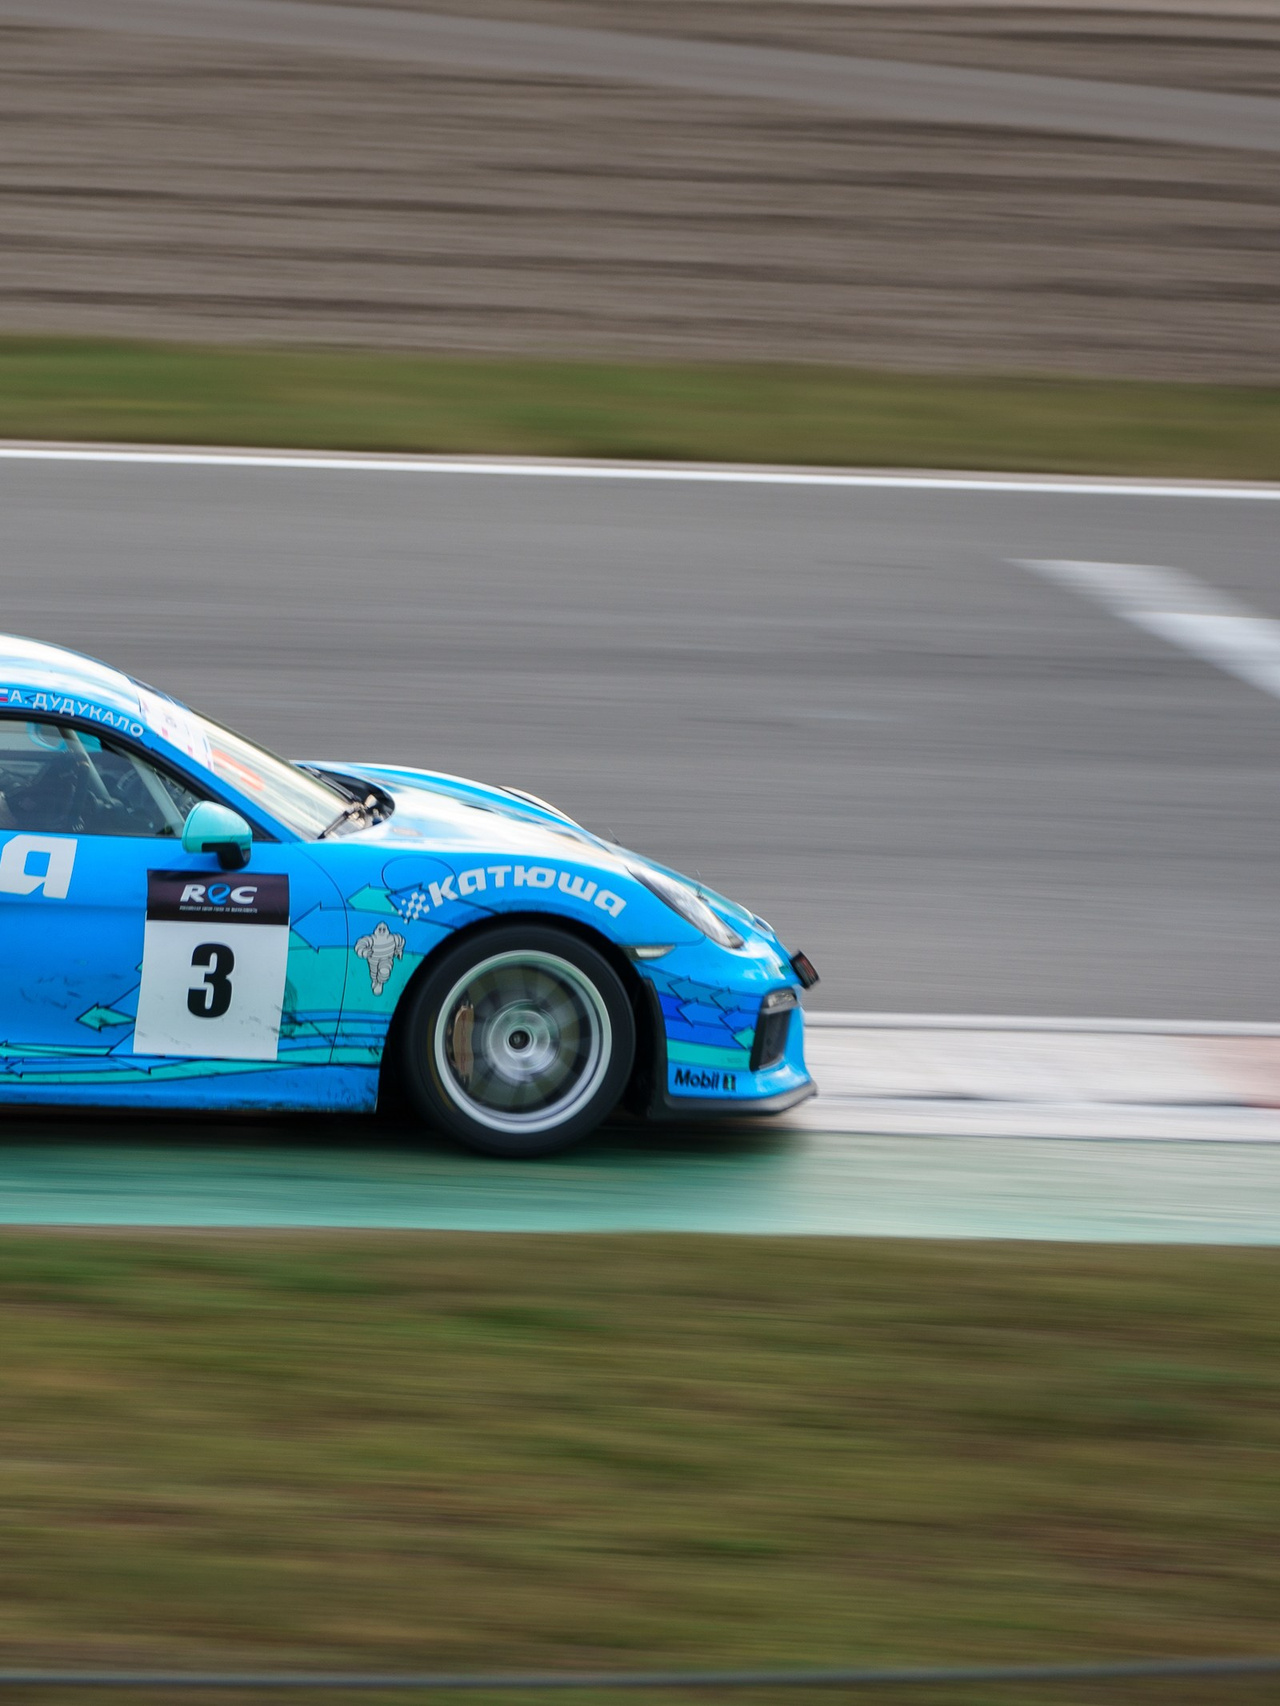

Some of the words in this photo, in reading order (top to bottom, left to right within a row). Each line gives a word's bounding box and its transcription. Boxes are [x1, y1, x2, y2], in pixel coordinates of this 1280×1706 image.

[31, 692, 145, 738] ДУДУКАЛО
[187, 943, 235, 1018] 3
[674, 1067, 720, 1091] Mobil
